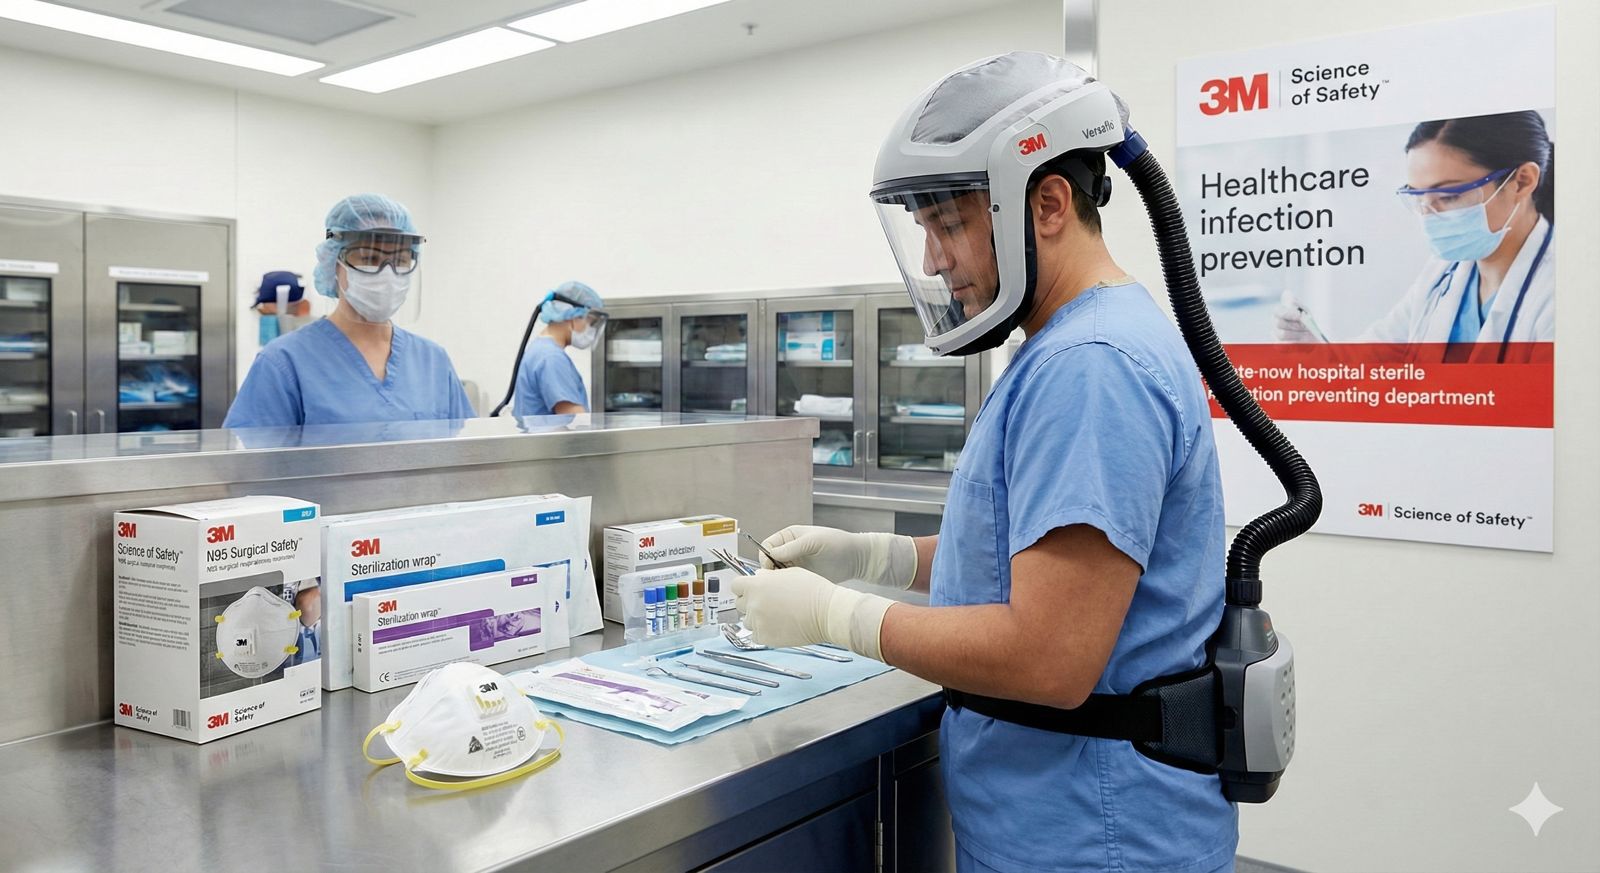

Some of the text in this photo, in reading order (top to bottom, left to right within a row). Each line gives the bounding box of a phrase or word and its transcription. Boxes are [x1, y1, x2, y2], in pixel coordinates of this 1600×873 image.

[1291, 63, 1370, 84] Science
[1199, 72, 1269, 116] 3M
[1291, 88, 1311, 106] of
[1081, 120, 1115, 140] Versaflo
[1018, 132, 1048, 156] 3M
[1202, 166, 1370, 199] Healthcare
[1201, 203, 1333, 235] infection
[1201, 238, 1365, 278] prevention
[1297, 363, 1365, 383] hospital
[1369, 363, 1426, 380] sterile
[1288, 386, 1380, 406] preventing
[1384, 387, 1496, 407] department
[1358, 503, 1383, 517] 3M
[1394, 506, 1452, 522] Science
[1456, 511, 1472, 523] of
[118, 521, 137, 539] 3M
[207, 524, 235, 544] 3M
[117, 542, 145, 558] Science
[146, 546, 155, 559] of
[206, 548, 228, 563] N95
[230, 542, 269, 559] Surgical
[351, 538, 380, 558] 3M
[639, 536, 655, 549] 3M
[351, 557, 410, 576] Sterilization
[377, 599, 397, 614] 3M
[377, 611, 420, 627] Sterilization
[236, 638, 248, 647] 3M
[479, 681, 498, 693] 3M
[119, 702, 133, 717] 3M
[207, 712, 229, 729] 3M
